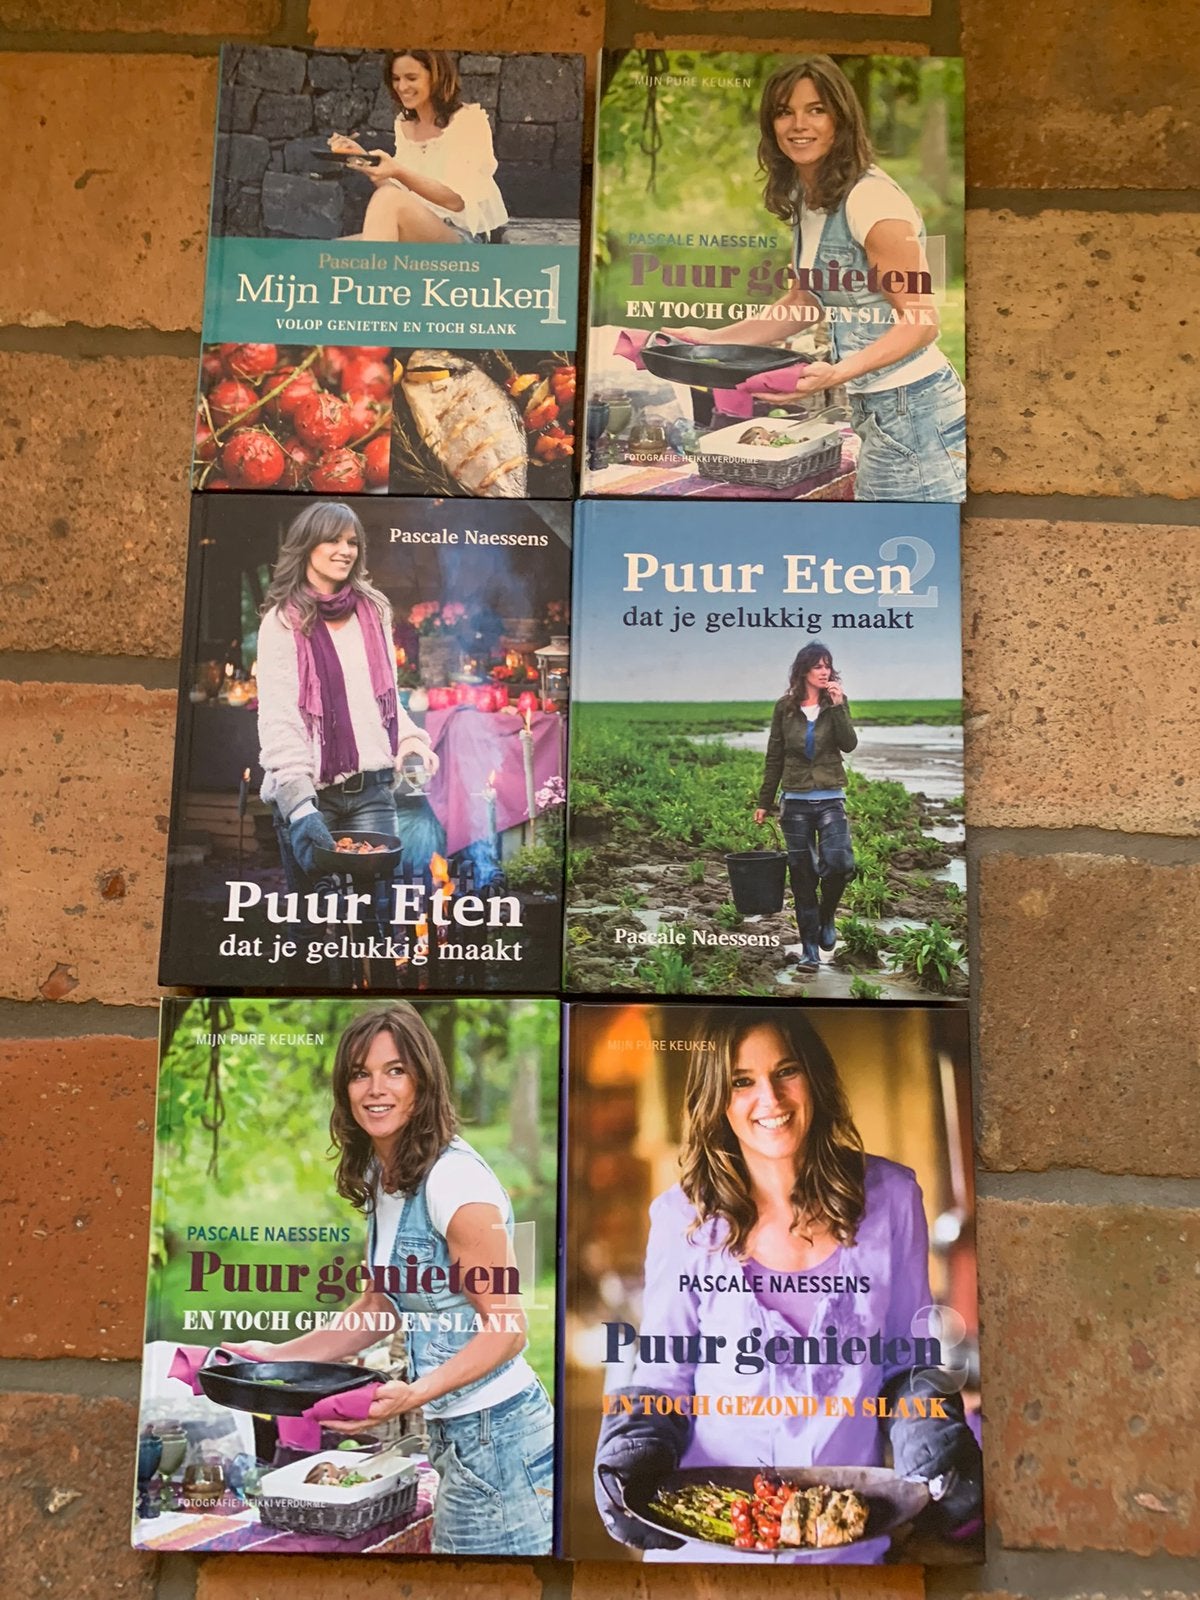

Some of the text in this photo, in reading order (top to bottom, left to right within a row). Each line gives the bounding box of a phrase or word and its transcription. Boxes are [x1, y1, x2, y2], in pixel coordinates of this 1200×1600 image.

[634, 76, 751, 88] MIJN PURE KEUKEN
[628, 233, 778, 249] PASCALE NAESSENS
[318, 253, 481, 273] Pascale Naessens
[629, 252, 936, 297] Puur genieten
[235, 273, 557, 313] Mijn Pure Keuken
[539, 264, 567, 325] 1
[625, 300, 937, 326] EN TOCH GEZOND EN SLANK
[275, 318, 518, 336] VOLOP GENIETEN EN TOCH SLANK
[623, 453, 680, 463] FOTOGRAFIE:
[389, 527, 549, 547] Pascale Naessens
[622, 552, 914, 595] Puur Eten
[878, 535, 939, 608] 2
[622, 605, 915, 634] dat je gelukkig maakt
[222, 880, 525, 928] Puur Eten
[218, 933, 524, 966] dat je gelukkig maakt
[614, 928, 781, 948] Pascale Naessens
[196, 1034, 325, 1047] MIJN PURE KEUKEN
[636, 1040, 667, 1050] PURE
[669, 1040, 716, 1051] KEUKEN
[187, 1226, 351, 1242] PASCALE NAESSENS
[185, 1251, 524, 1304] Puur genieten
[679, 1275, 871, 1293] PASCALE NAESSENS
[182, 1310, 523, 1333] EN TOCH GEZOND EN SLANK
[601, 1322, 946, 1375] Puur genieten
[602, 1395, 949, 1418] EN TOCH GEZOND EN SLANK
